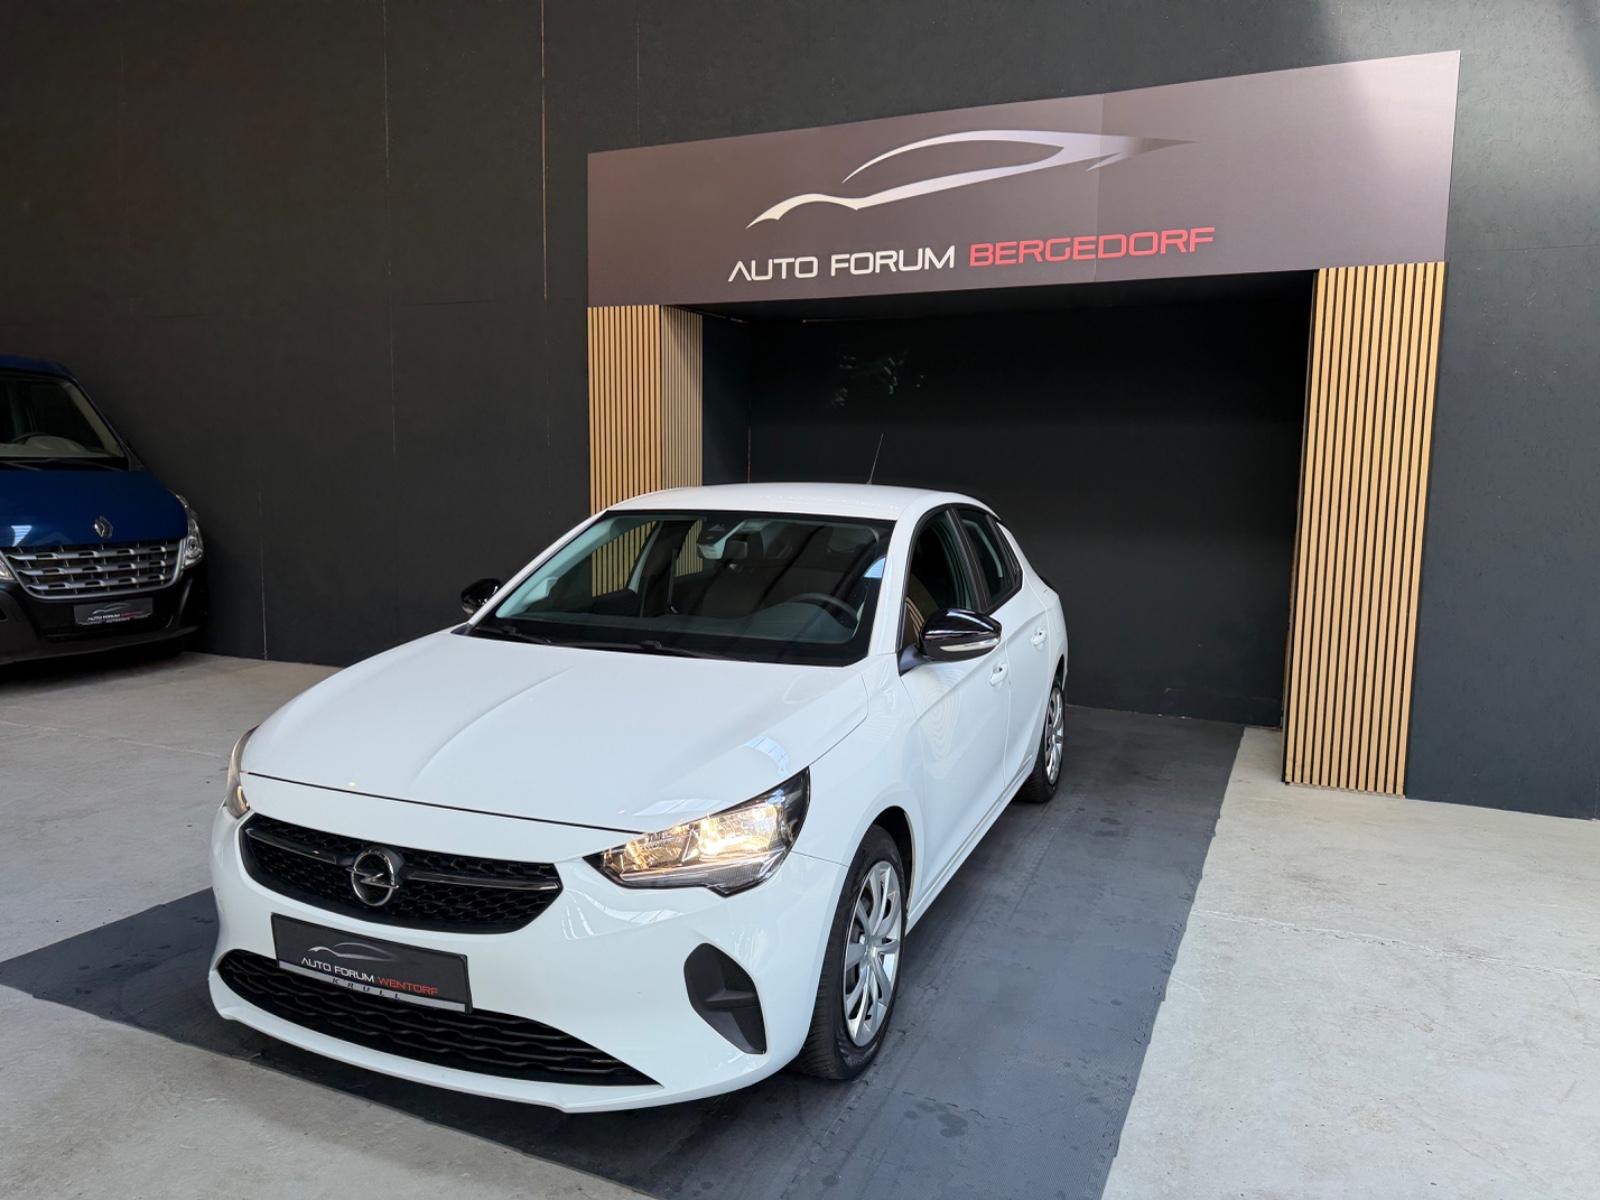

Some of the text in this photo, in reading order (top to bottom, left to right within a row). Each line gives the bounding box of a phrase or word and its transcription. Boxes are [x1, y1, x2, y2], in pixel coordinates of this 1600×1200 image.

[727, 226, 1216, 282] AUTO FORUM BERGEDORF
[301, 957, 438, 995] AUTO FORUM WENTORF
